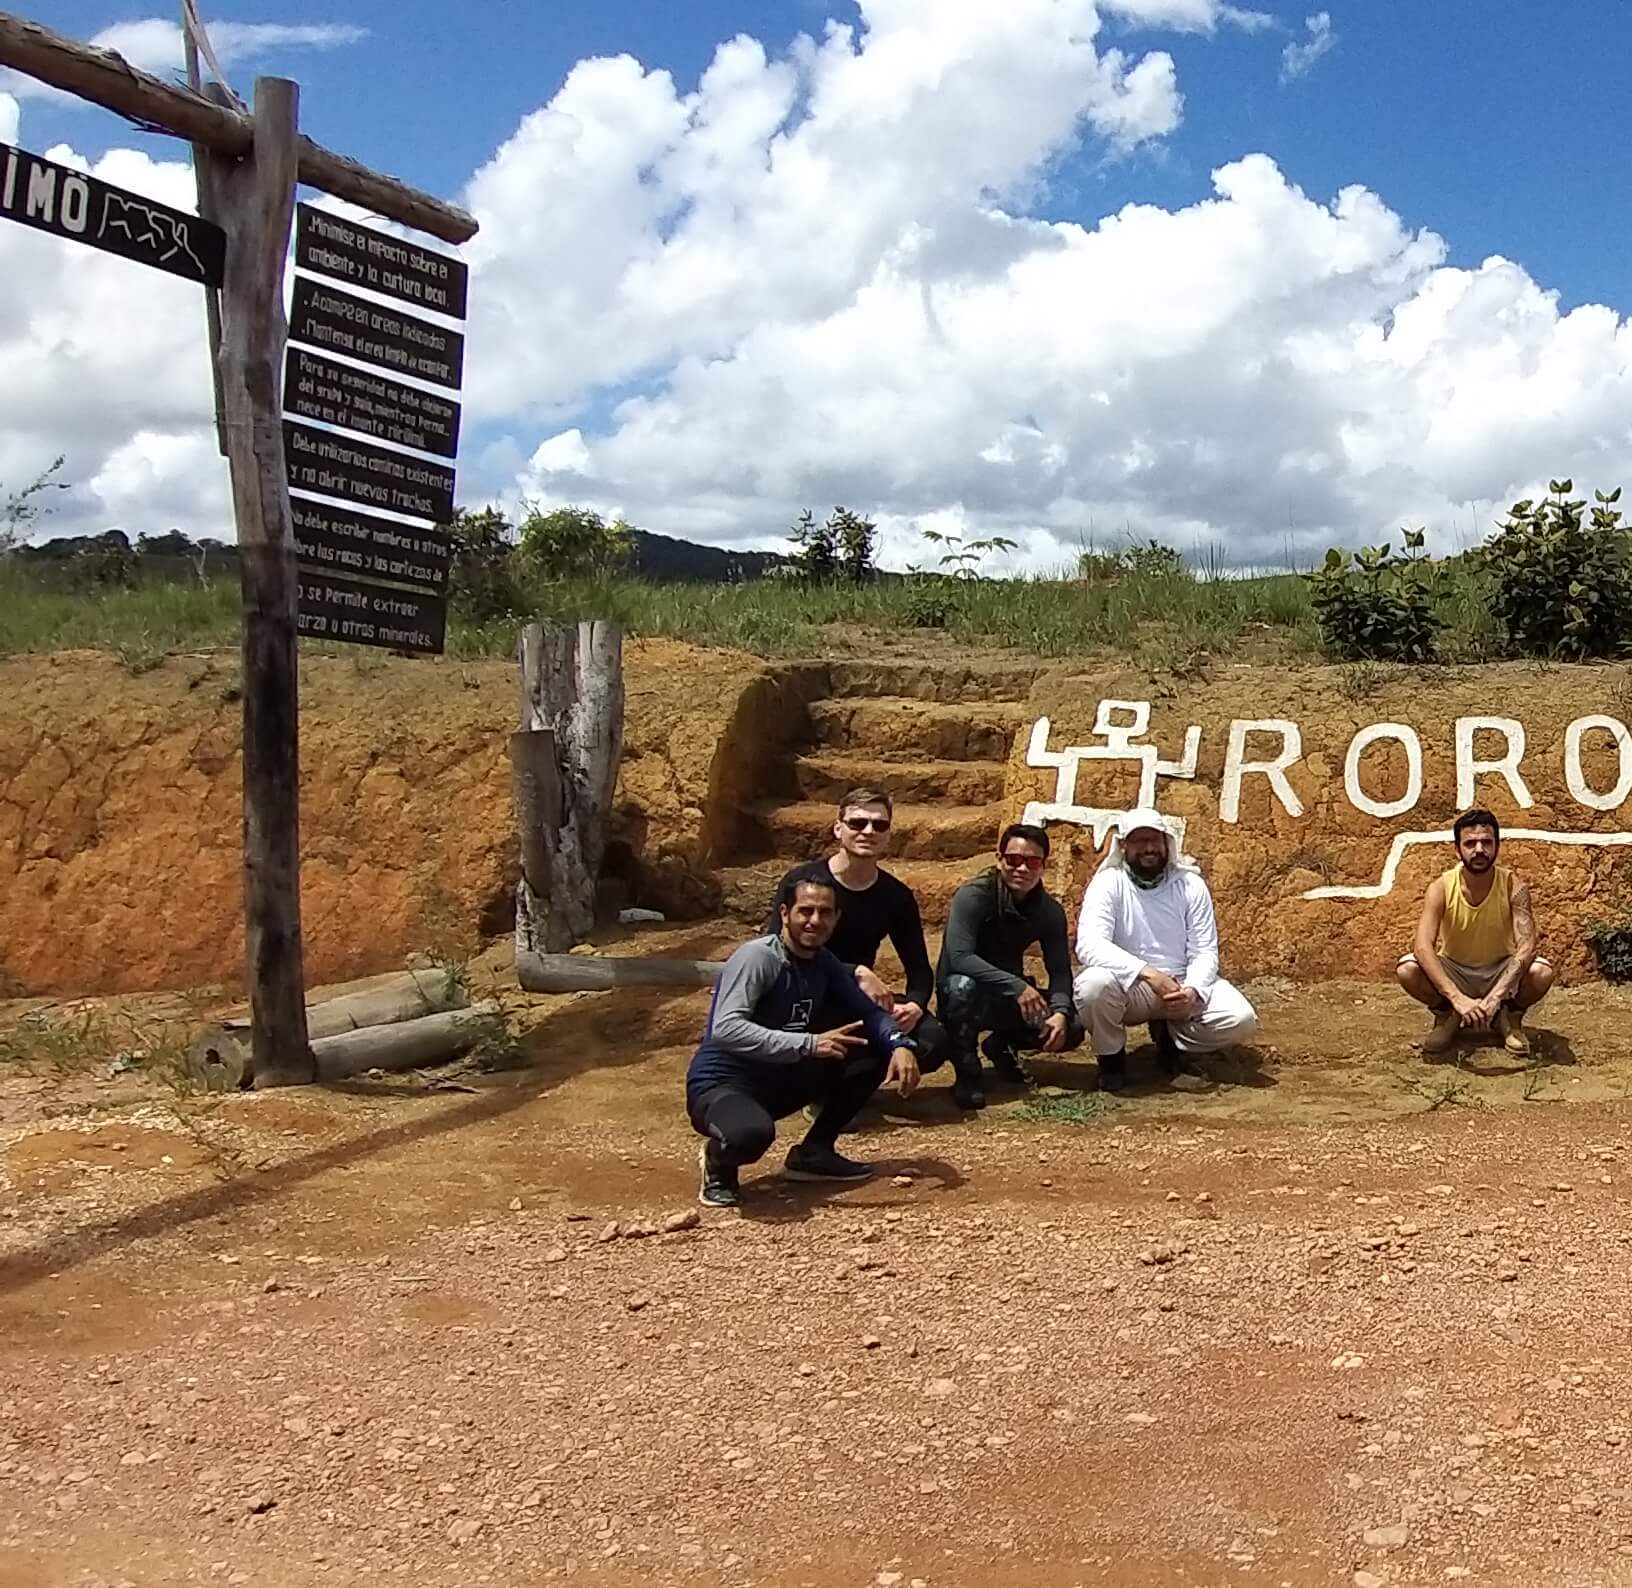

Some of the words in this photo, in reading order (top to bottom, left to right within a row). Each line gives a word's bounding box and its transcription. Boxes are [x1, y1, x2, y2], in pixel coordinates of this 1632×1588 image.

[300, 353, 324, 377] Para
[293, 432, 316, 453] Debe
[304, 512, 328, 531] debe
